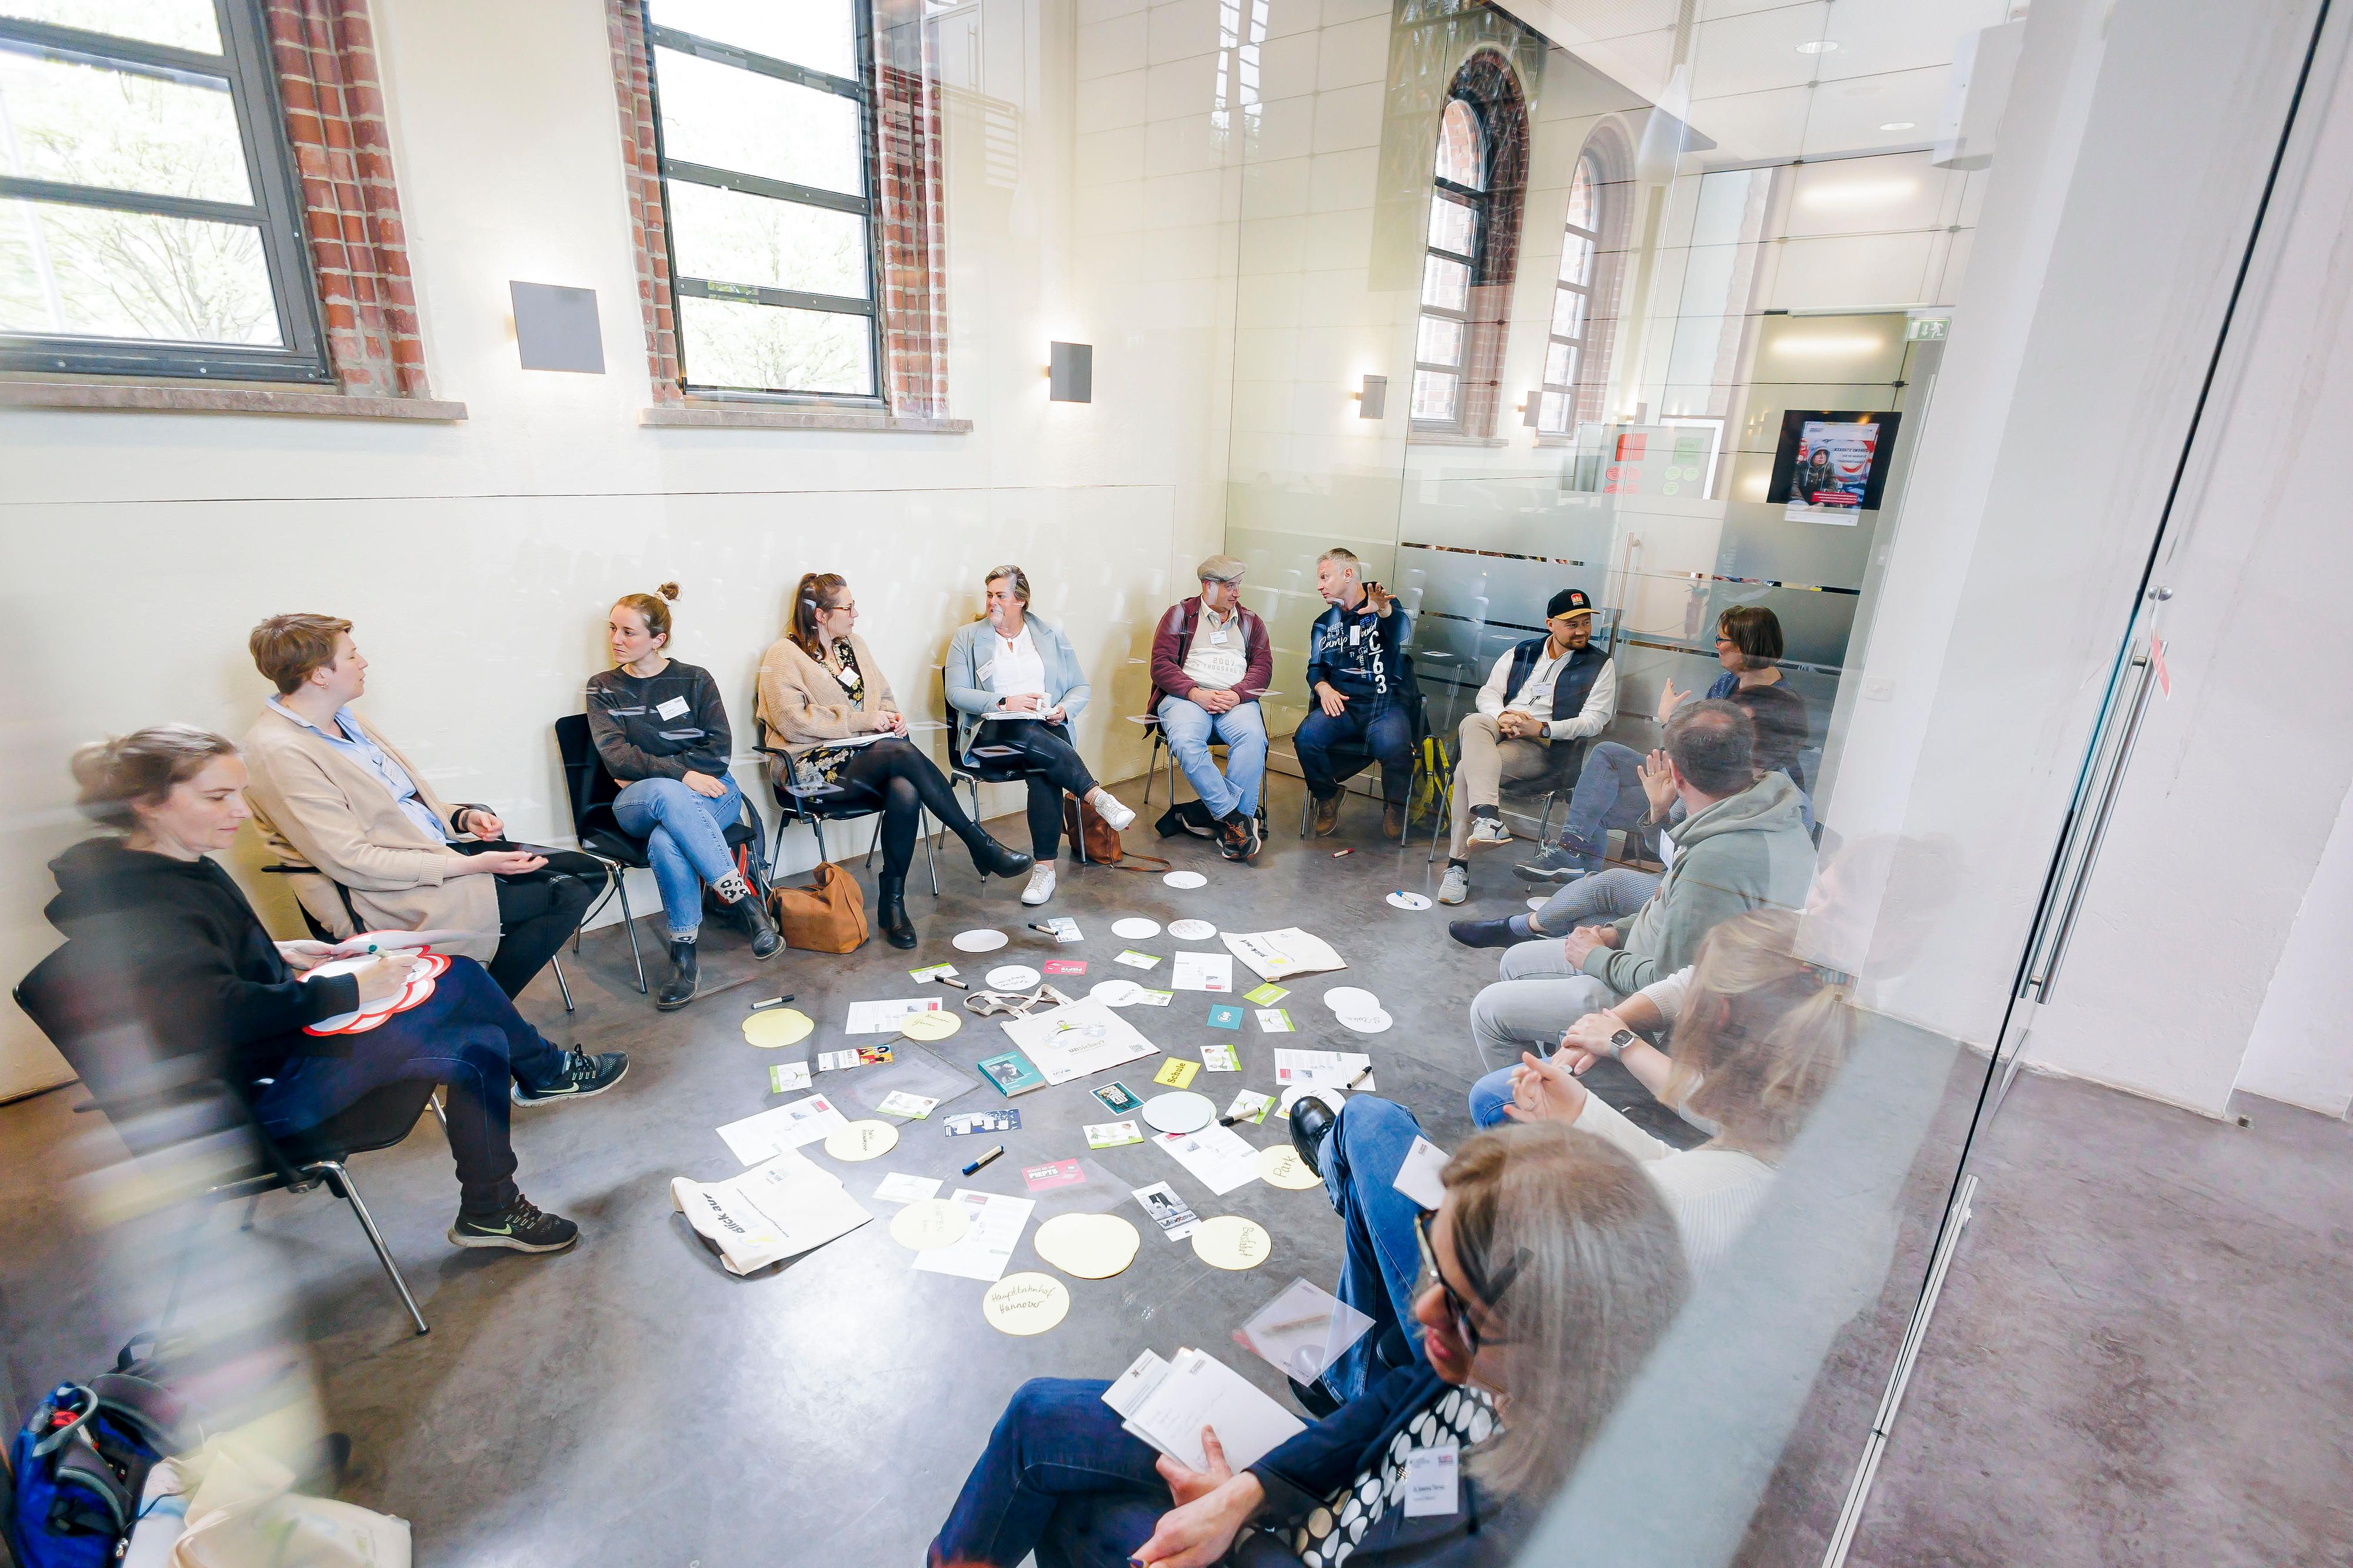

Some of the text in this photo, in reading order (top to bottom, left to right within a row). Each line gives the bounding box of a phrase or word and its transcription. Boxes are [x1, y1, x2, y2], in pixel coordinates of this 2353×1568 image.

[1319, 636, 1348, 652] Camp
[1213, 657, 1235, 666] 2007
[1068, 1040, 1105, 1053] unsicher?
[1167, 1063, 1185, 1083] Schule
[1273, 1156, 1297, 1178] Park
[991, 1285, 1056, 1302] Hauptbahnhof
[999, 1300, 1045, 1314] Hannover
